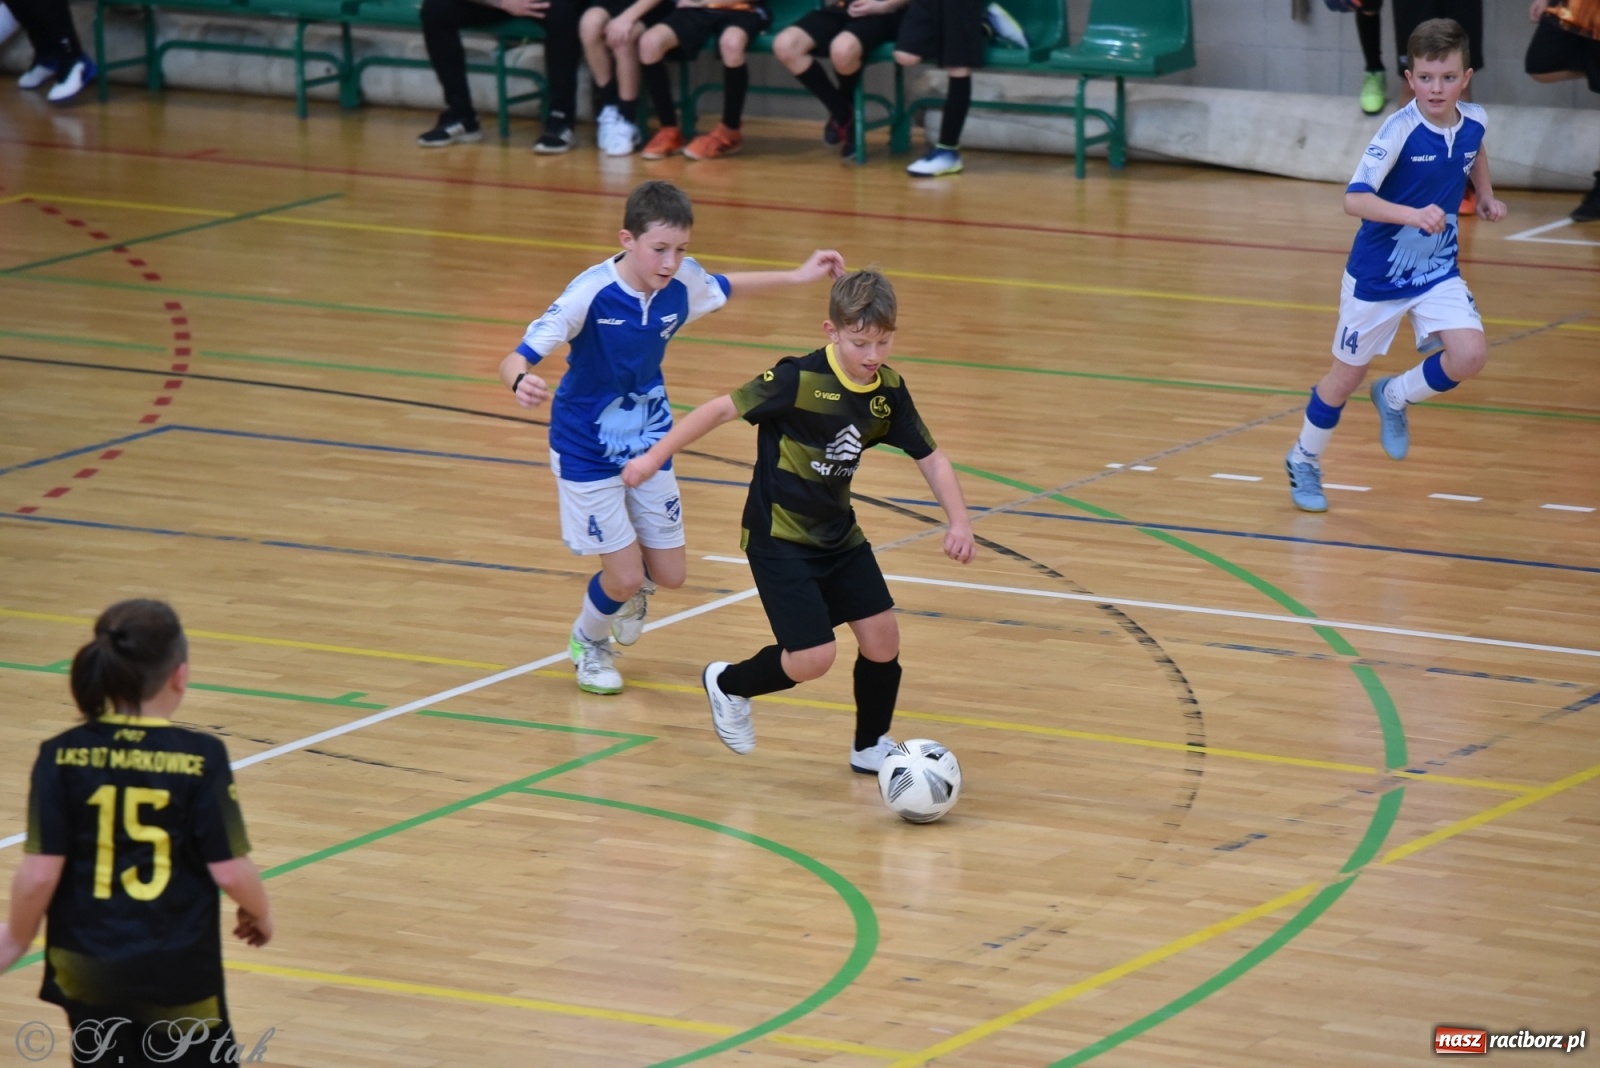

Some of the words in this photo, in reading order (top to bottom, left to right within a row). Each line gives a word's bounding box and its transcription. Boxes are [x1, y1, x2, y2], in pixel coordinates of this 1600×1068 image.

[1341, 326, 1359, 355] 14
[822, 391, 841, 401] VIGO
[587, 514, 604, 543] 4
[55, 747, 89, 767] LKS
[109, 749, 206, 777] MARKOWICE
[87, 784, 172, 902] 15
